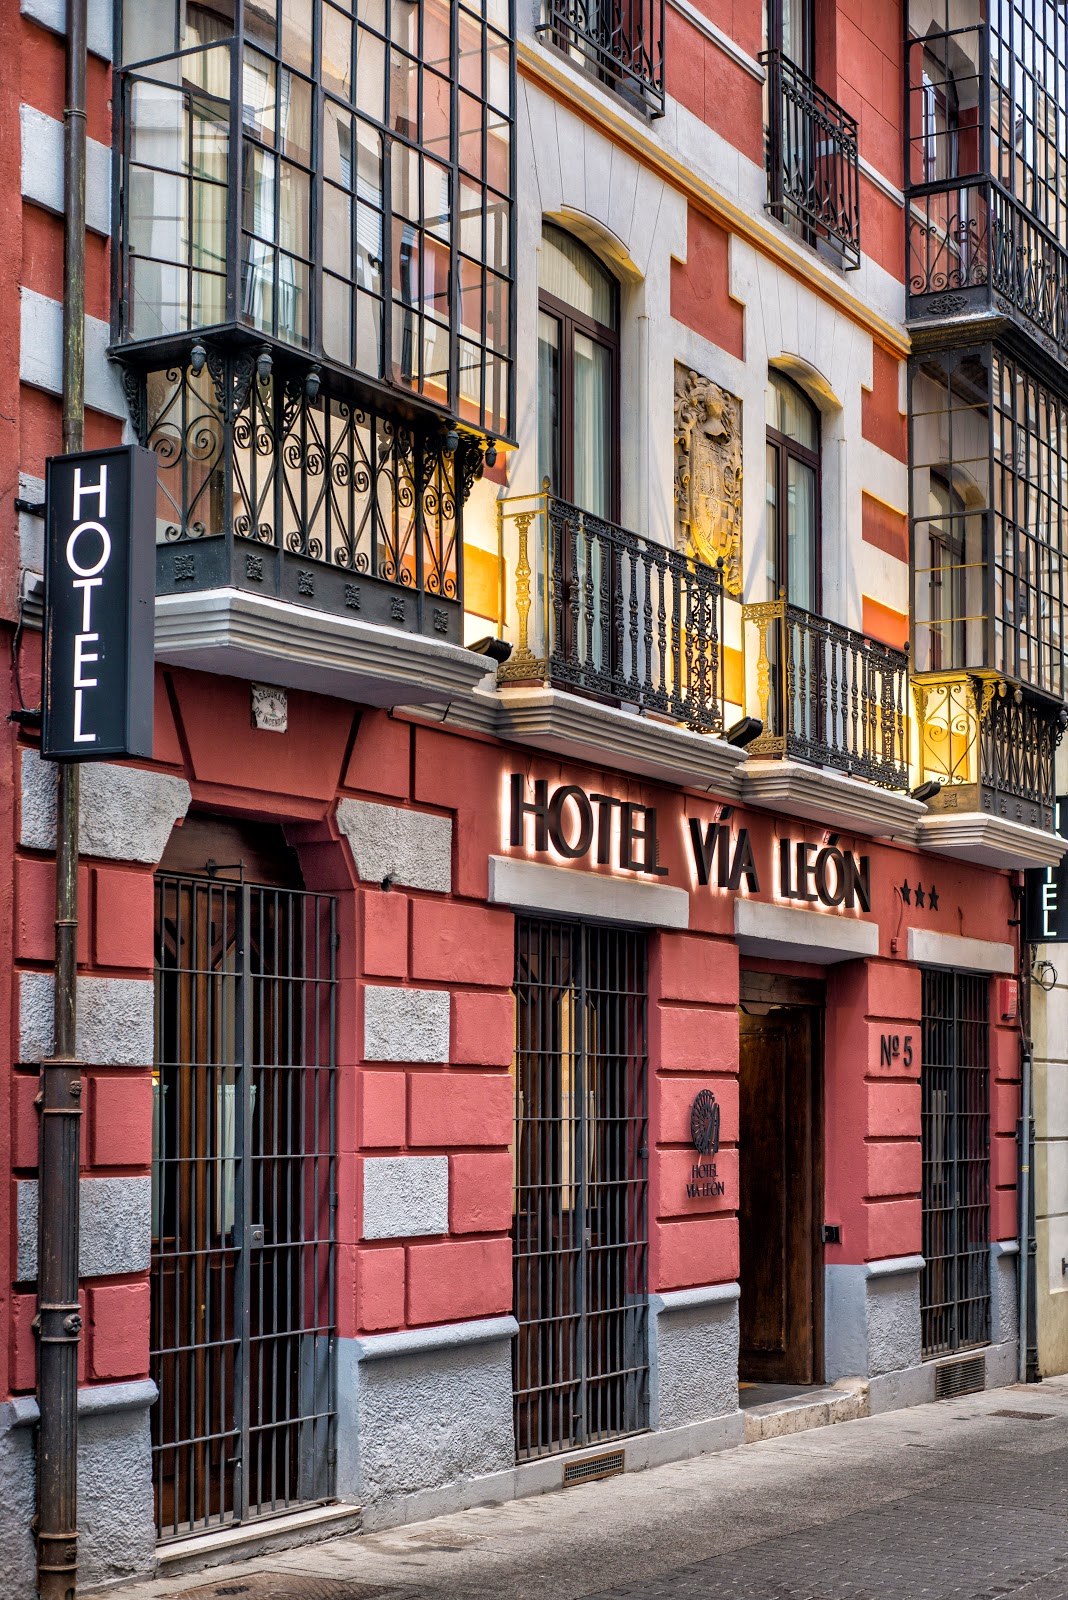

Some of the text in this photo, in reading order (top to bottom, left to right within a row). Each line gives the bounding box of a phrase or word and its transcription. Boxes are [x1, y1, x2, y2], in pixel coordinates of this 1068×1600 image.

[66, 464, 111, 742] HOTEL
[255, 706, 263, 718] DE
[510, 773, 871, 912] HOTEL VÍA LEÓN
[903, 1035, 913, 1067] 5
[692, 1163, 718, 1178] HOTEL
